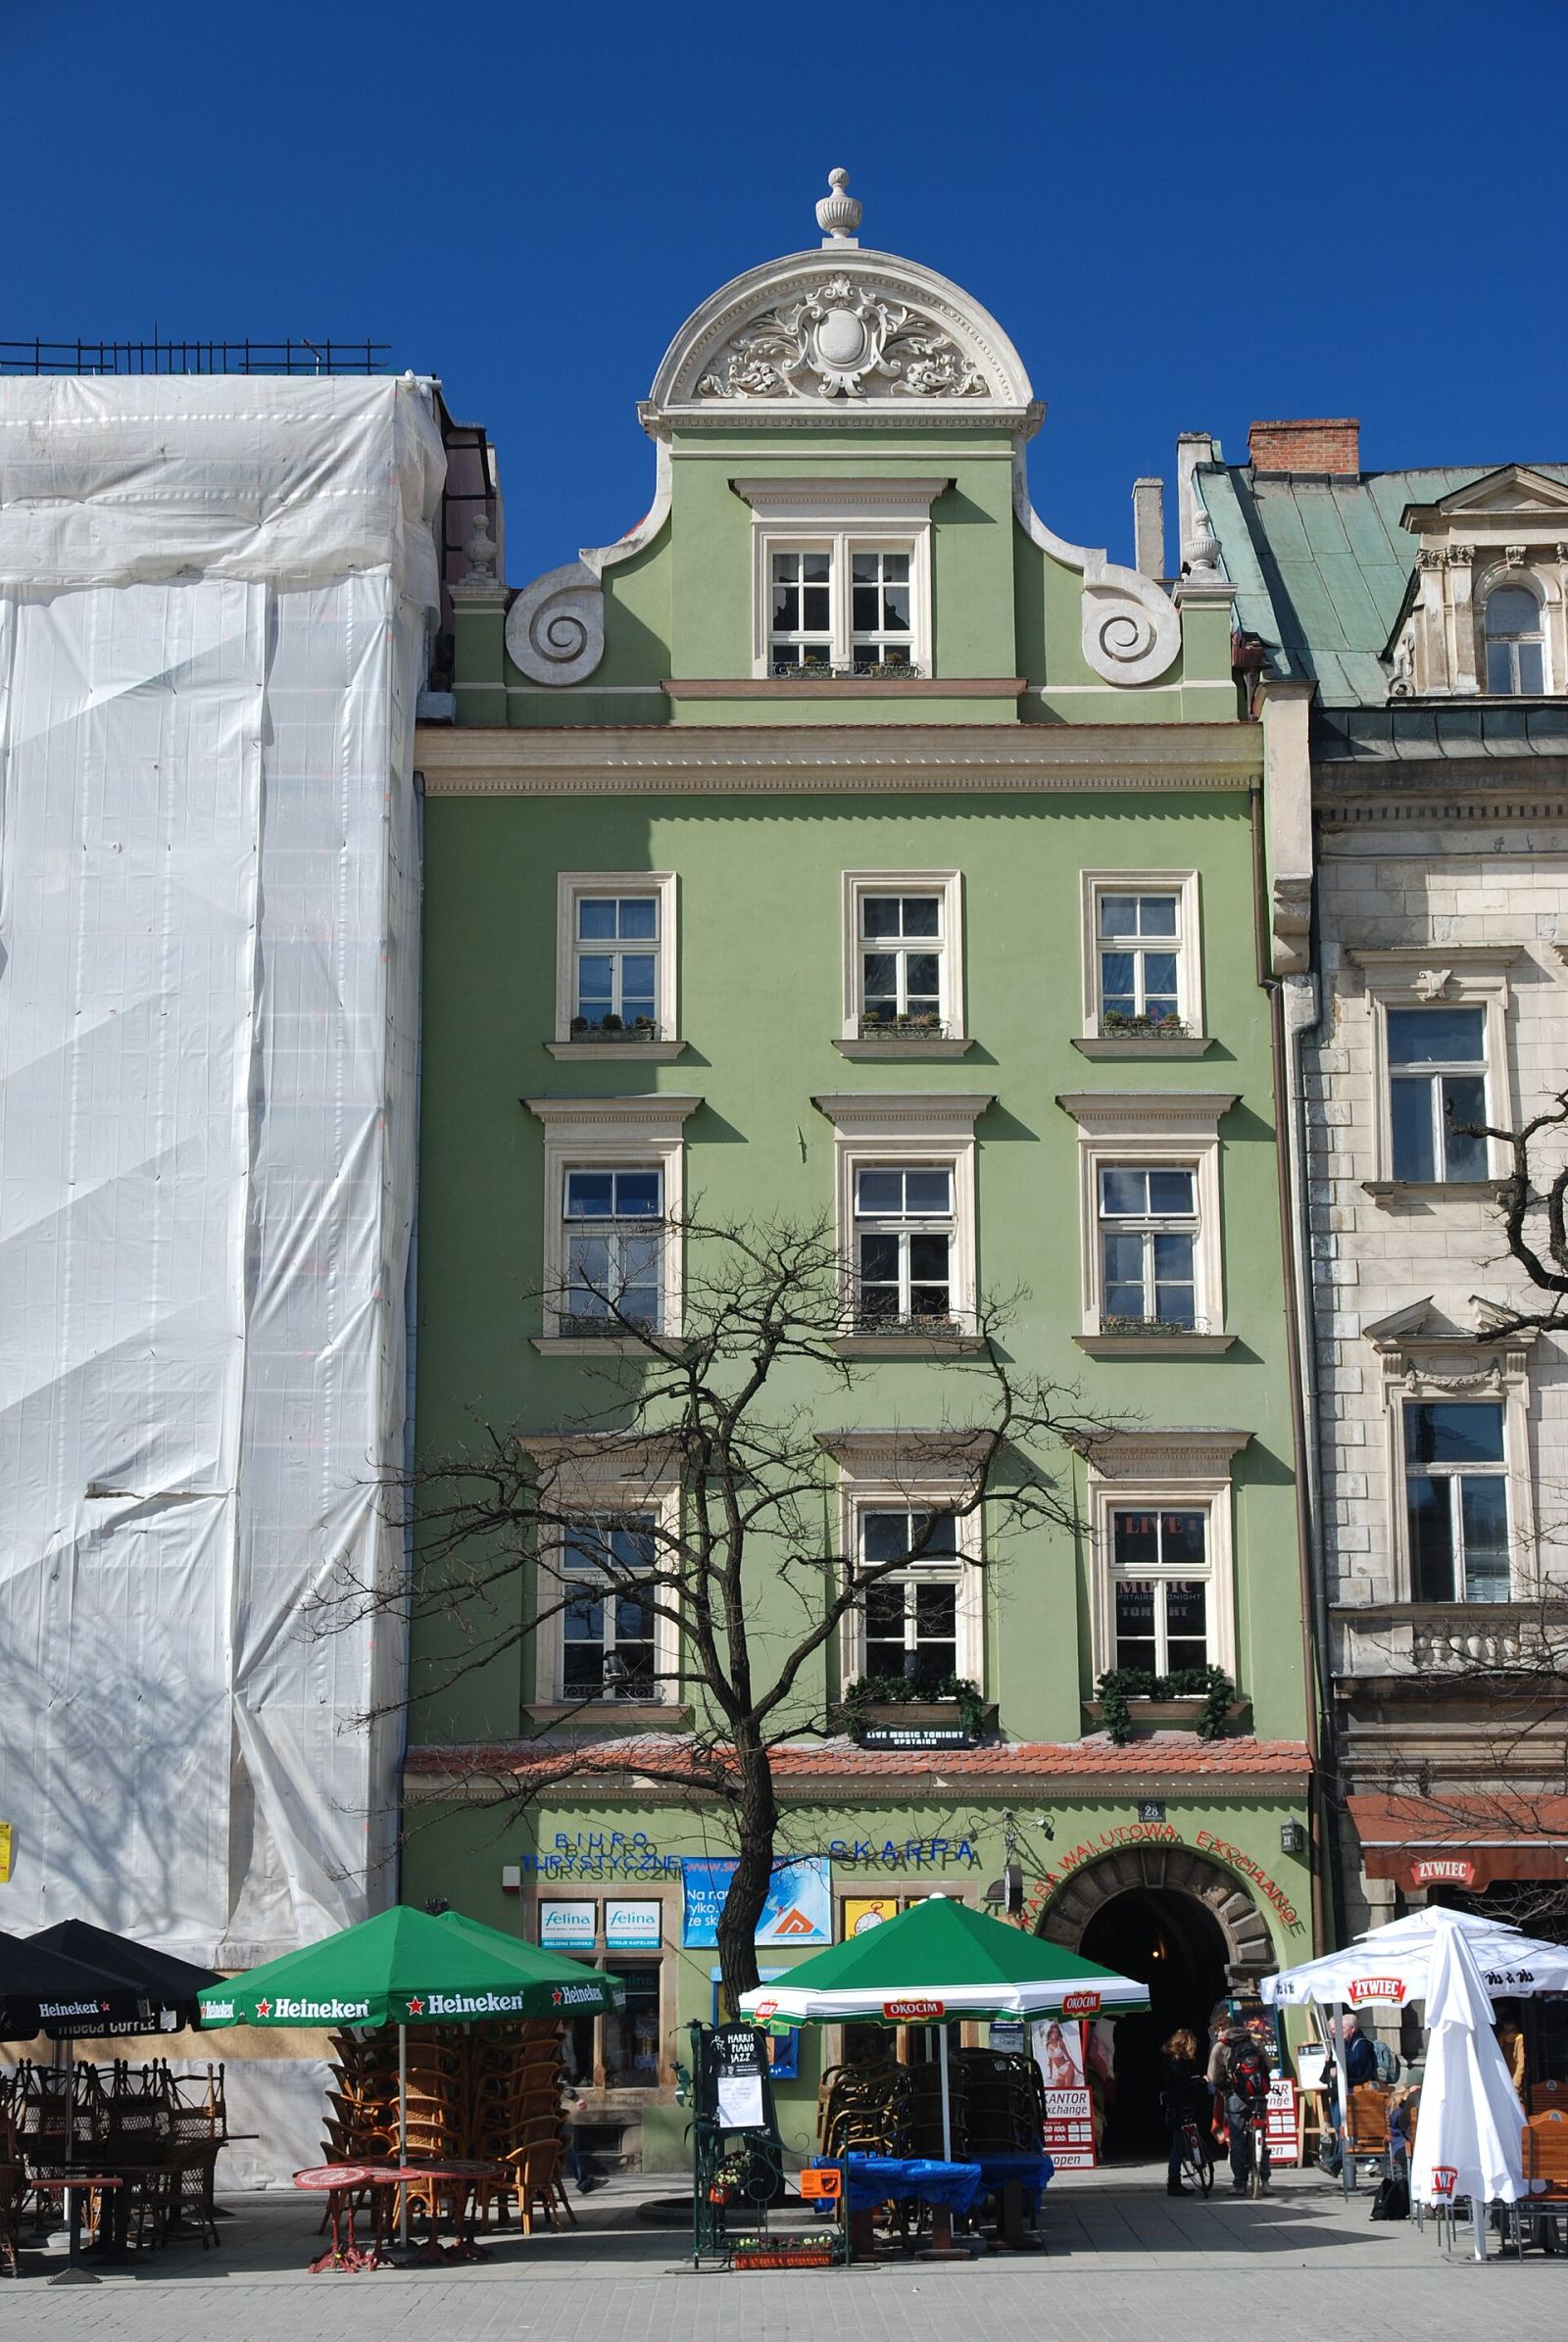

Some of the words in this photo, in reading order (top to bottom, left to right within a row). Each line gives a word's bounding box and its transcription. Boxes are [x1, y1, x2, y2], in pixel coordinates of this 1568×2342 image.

[1119, 1581, 1193, 1594] MUIC
[866, 1731, 887, 1739] LIVE
[889, 1731, 921, 1739] MUSIC
[923, 1731, 964, 1739] TONIGHT
[1145, 1805, 1159, 1817] 28
[555, 1832, 648, 1848] BIURO
[830, 1838, 974, 1862] SKARPA
[1057, 1822, 1178, 1873] WALUTOWA
[687, 1888, 706, 1901] Na
[545, 1911, 591, 1927] felina
[610, 1910, 656, 1927] felina
[561, 1982, 604, 2005] Heineken
[1354, 1978, 1400, 1996] ŻYWIEC
[38, 1999, 100, 2018] Heineken
[273, 1998, 369, 2019] Heineken
[427, 1992, 523, 2015] Heineken
[890, 2002, 939, 2015] OKOCIM
[1066, 1996, 1097, 2009] OKOCIM
[205, 2000, 234, 2020] Heineken
[727, 2033, 755, 2044] HARRIS
[731, 2043, 755, 2053] PIANO
[730, 2053, 751, 2064] JAZZ
[1047, 2105, 1088, 2116] xchange
[1054, 2156, 1081, 2167] open
